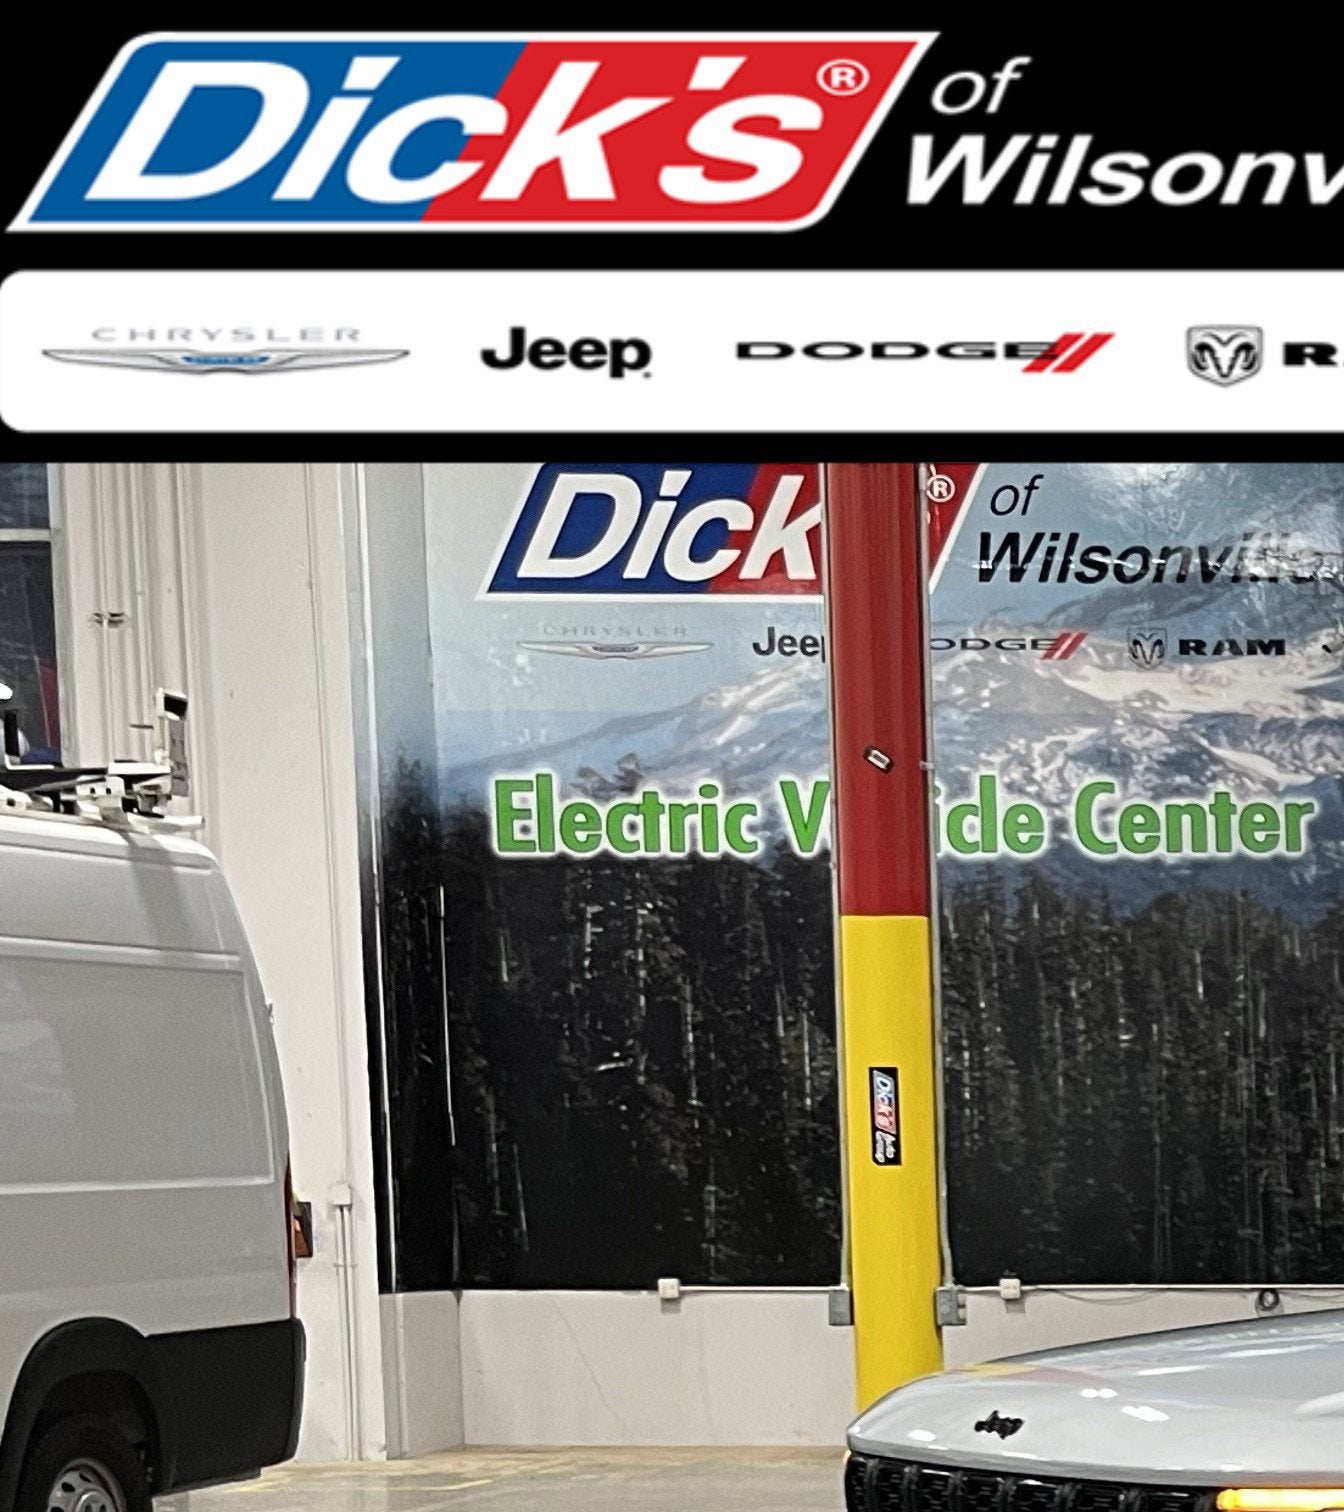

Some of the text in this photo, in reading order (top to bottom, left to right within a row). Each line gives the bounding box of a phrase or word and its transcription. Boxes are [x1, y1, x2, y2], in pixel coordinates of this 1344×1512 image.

[990, 474, 1045, 517] of
[752, 625, 825, 663] Jee
[929, 637, 1058, 651] ODGE
[1178, 638, 1287, 656] RAM
[494, 772, 760, 854] Electric
[1074, 780, 1316, 856] Center
